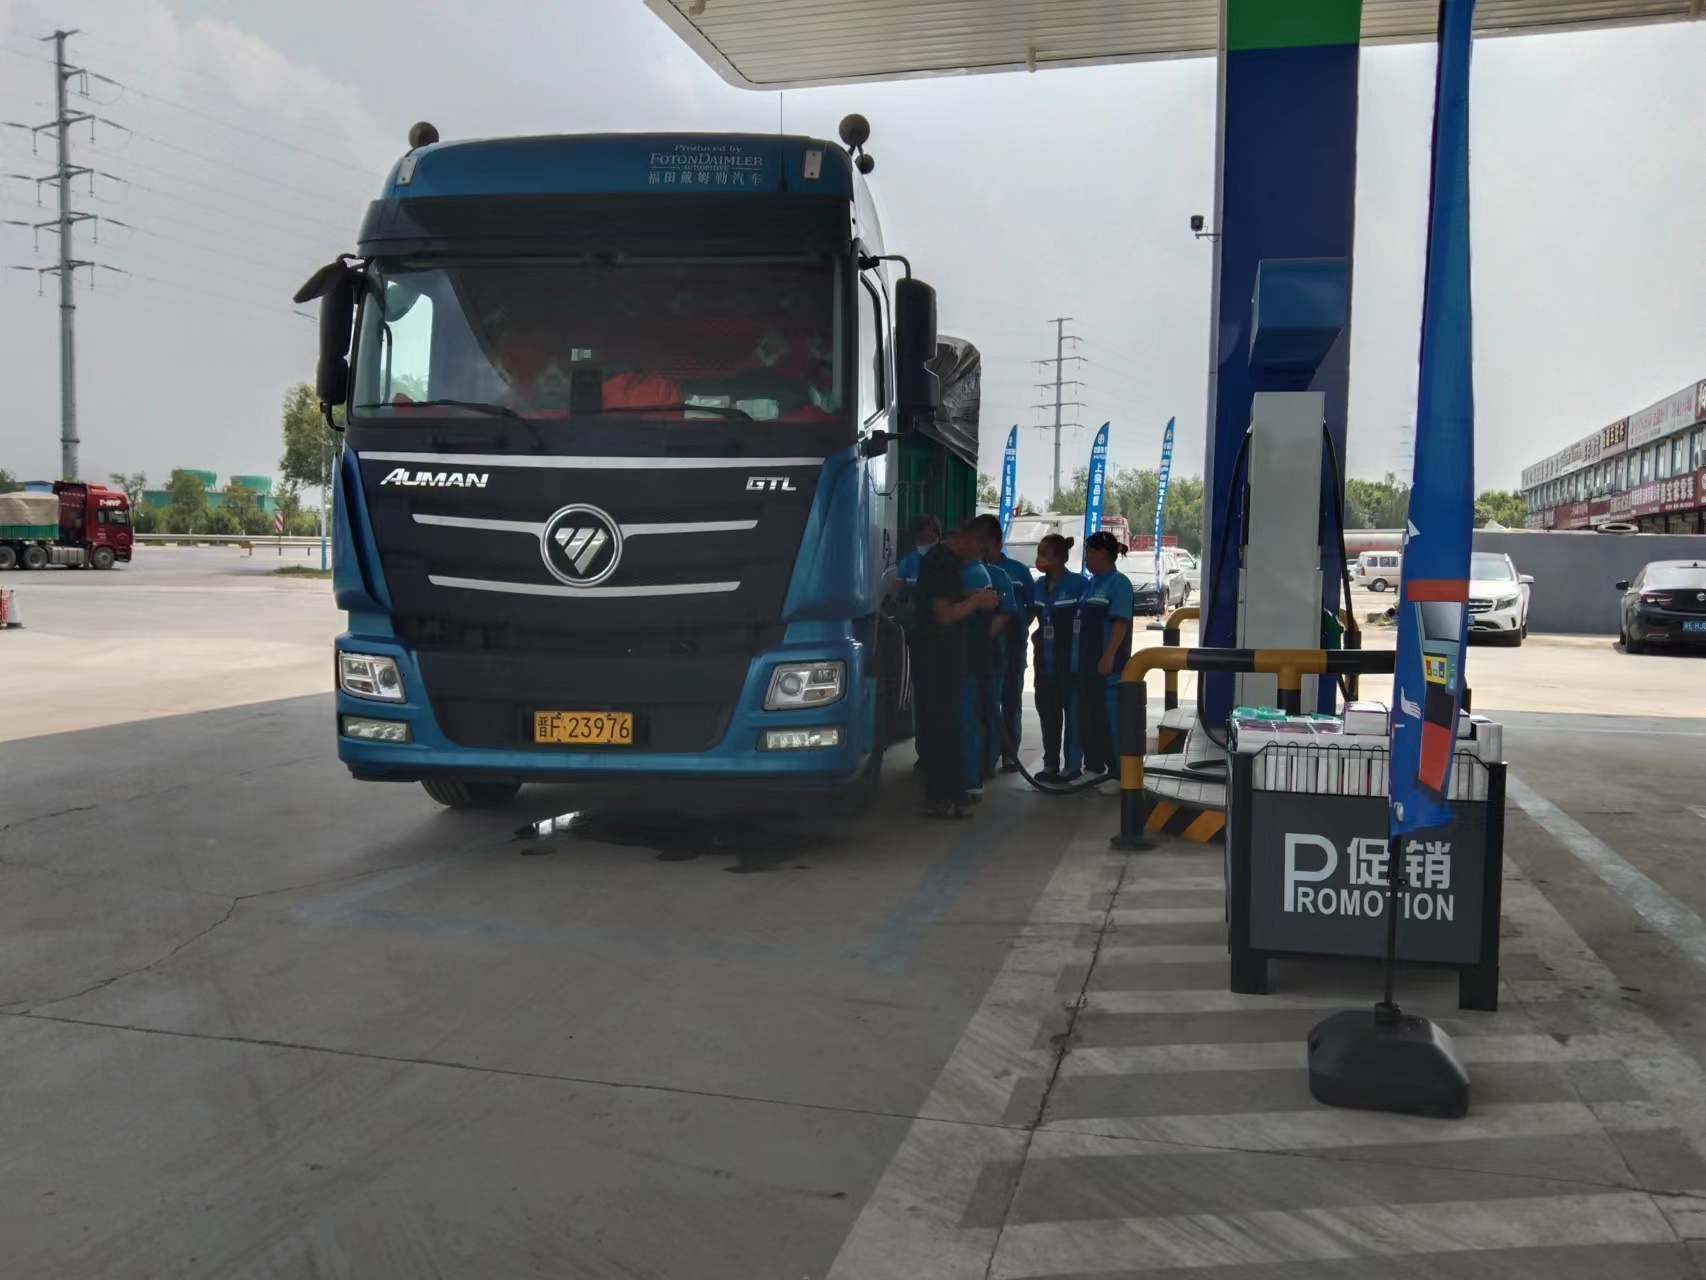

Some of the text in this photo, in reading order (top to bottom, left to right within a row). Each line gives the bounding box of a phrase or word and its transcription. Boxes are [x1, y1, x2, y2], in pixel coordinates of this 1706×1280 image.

[648, 171, 762, 186] 福田戴姆勒汽车
[380, 468, 489, 489] AUMAN
[745, 476, 797, 491] GTL
[1347, 837, 1451, 889] 促销
